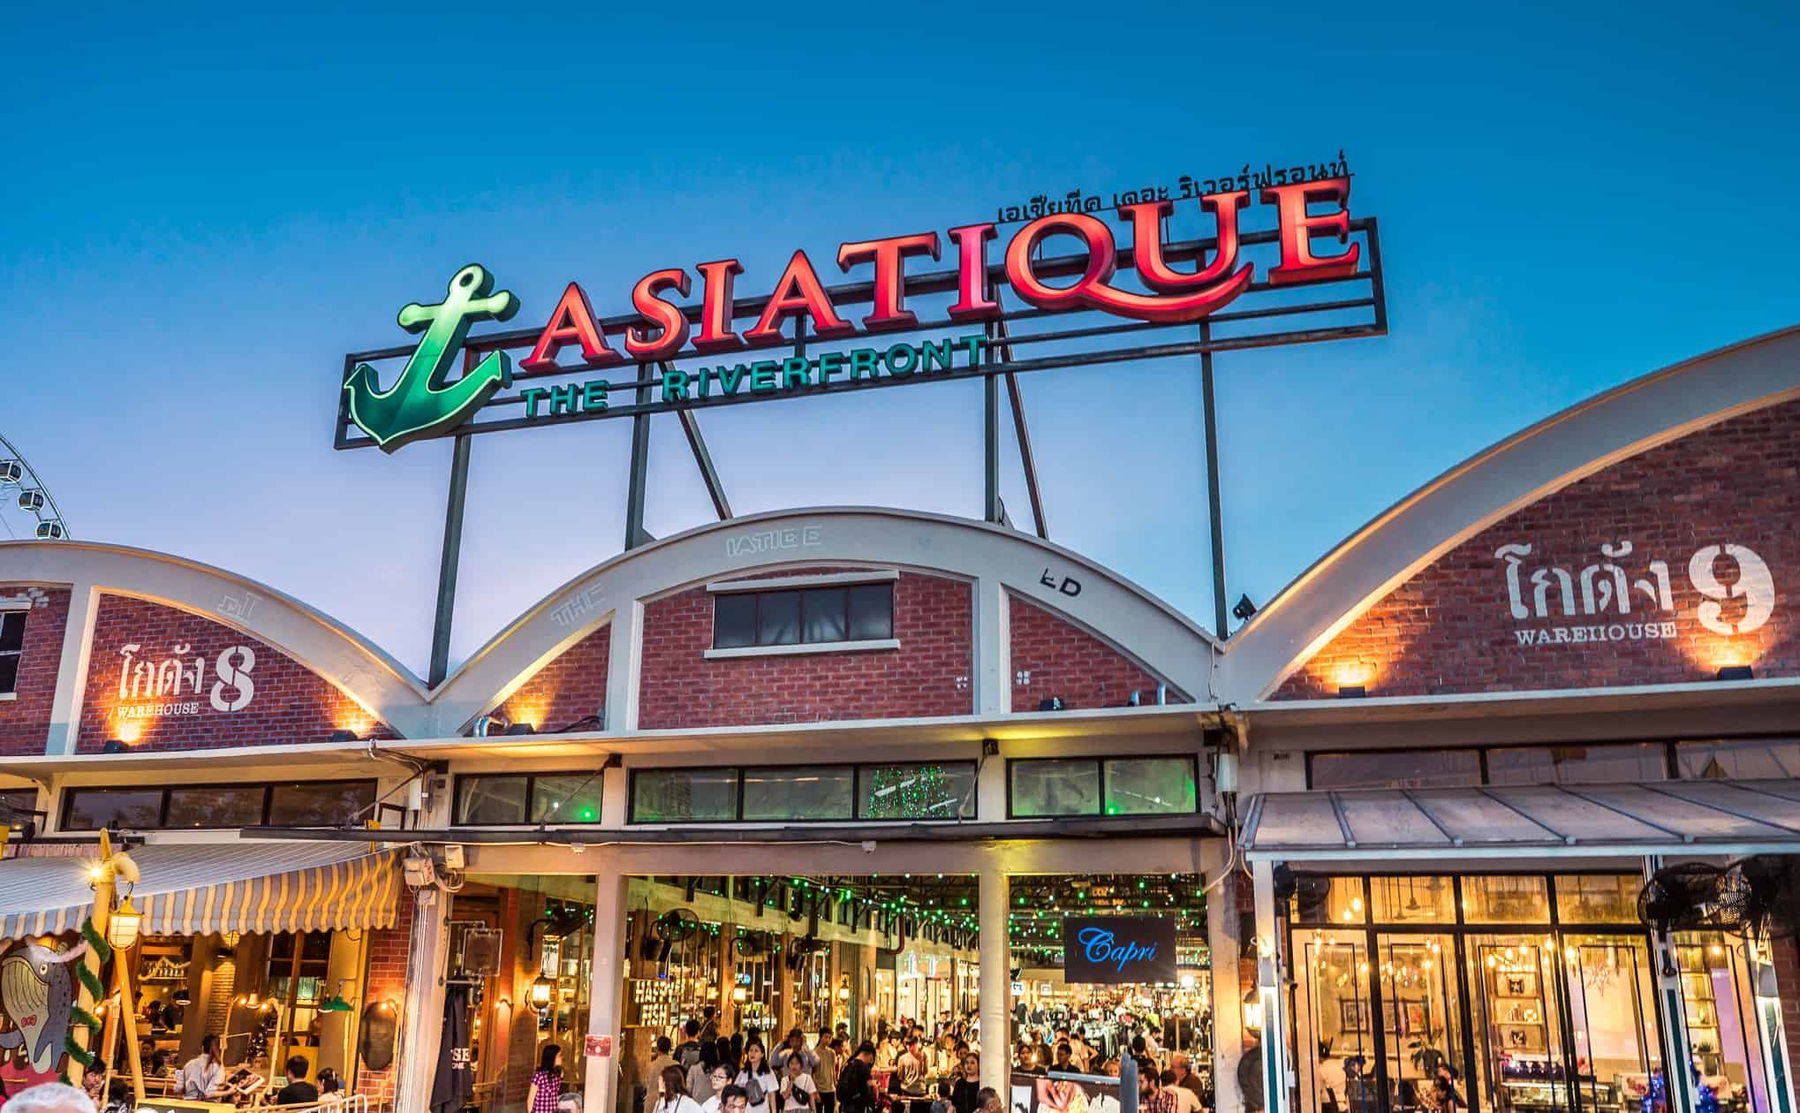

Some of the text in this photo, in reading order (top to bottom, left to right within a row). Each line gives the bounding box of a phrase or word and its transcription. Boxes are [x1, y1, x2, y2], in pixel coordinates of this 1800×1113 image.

[518, 175, 1360, 373] ASIATIQUE
[520, 335, 989, 421] THE RIVERFRONT
[1495, 540, 1776, 636] โกดัง 9
[1515, 622, 1677, 646] WAREHOUSE
[117, 702, 199, 720] WAREHOUSE
[119, 643, 256, 712] โกดัง 8
[1078, 926, 1158, 973] Capri
